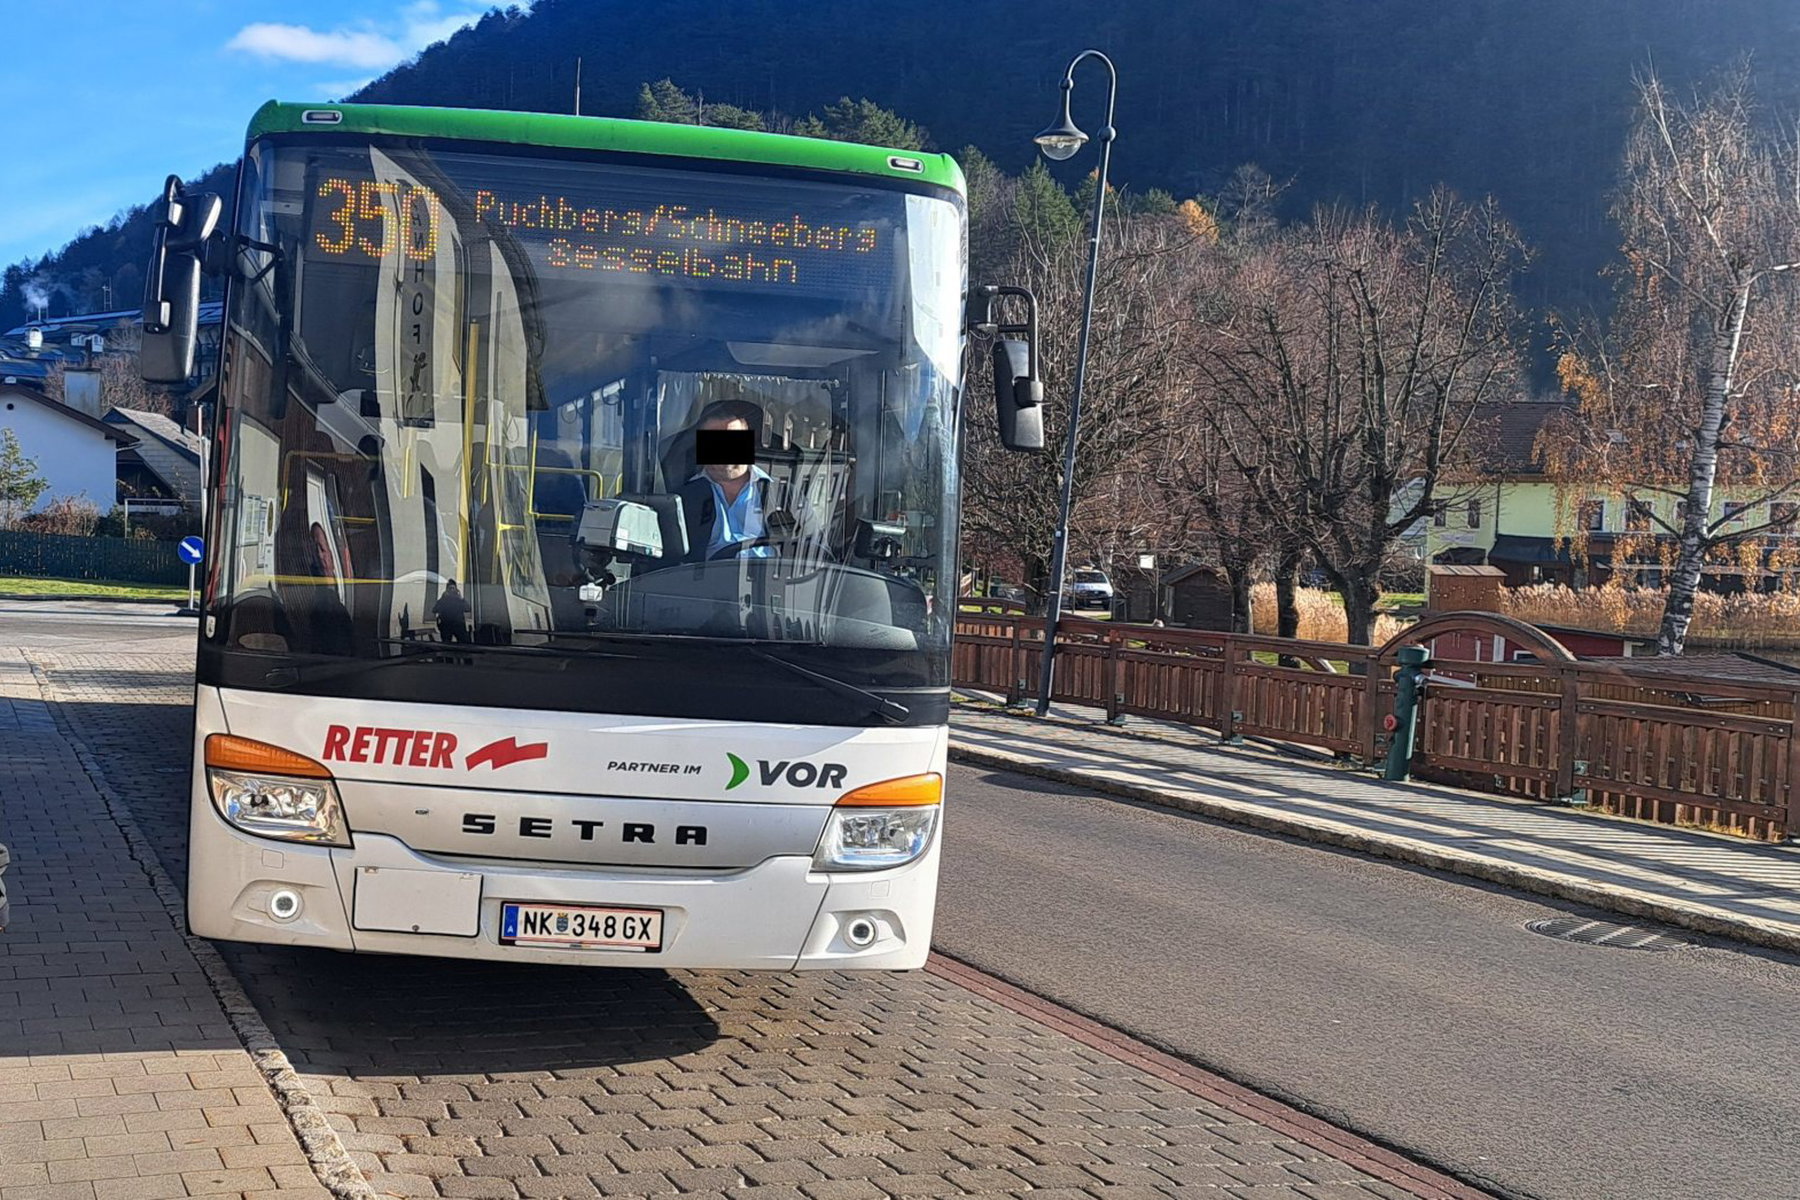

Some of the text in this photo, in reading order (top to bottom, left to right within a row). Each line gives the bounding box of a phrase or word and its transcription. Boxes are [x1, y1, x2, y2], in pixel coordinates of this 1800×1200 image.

[316, 178, 439, 260] 350
[475, 190, 877, 252] Puchberg/Schneeberg
[548, 238, 797, 283] Sesselbahn
[322, 725, 458, 769] RETTER
[607, 760, 848, 788] PARTNER IM VOR
[462, 813, 707, 845] SETRA
[524, 911, 652, 940] NK 348 GX
